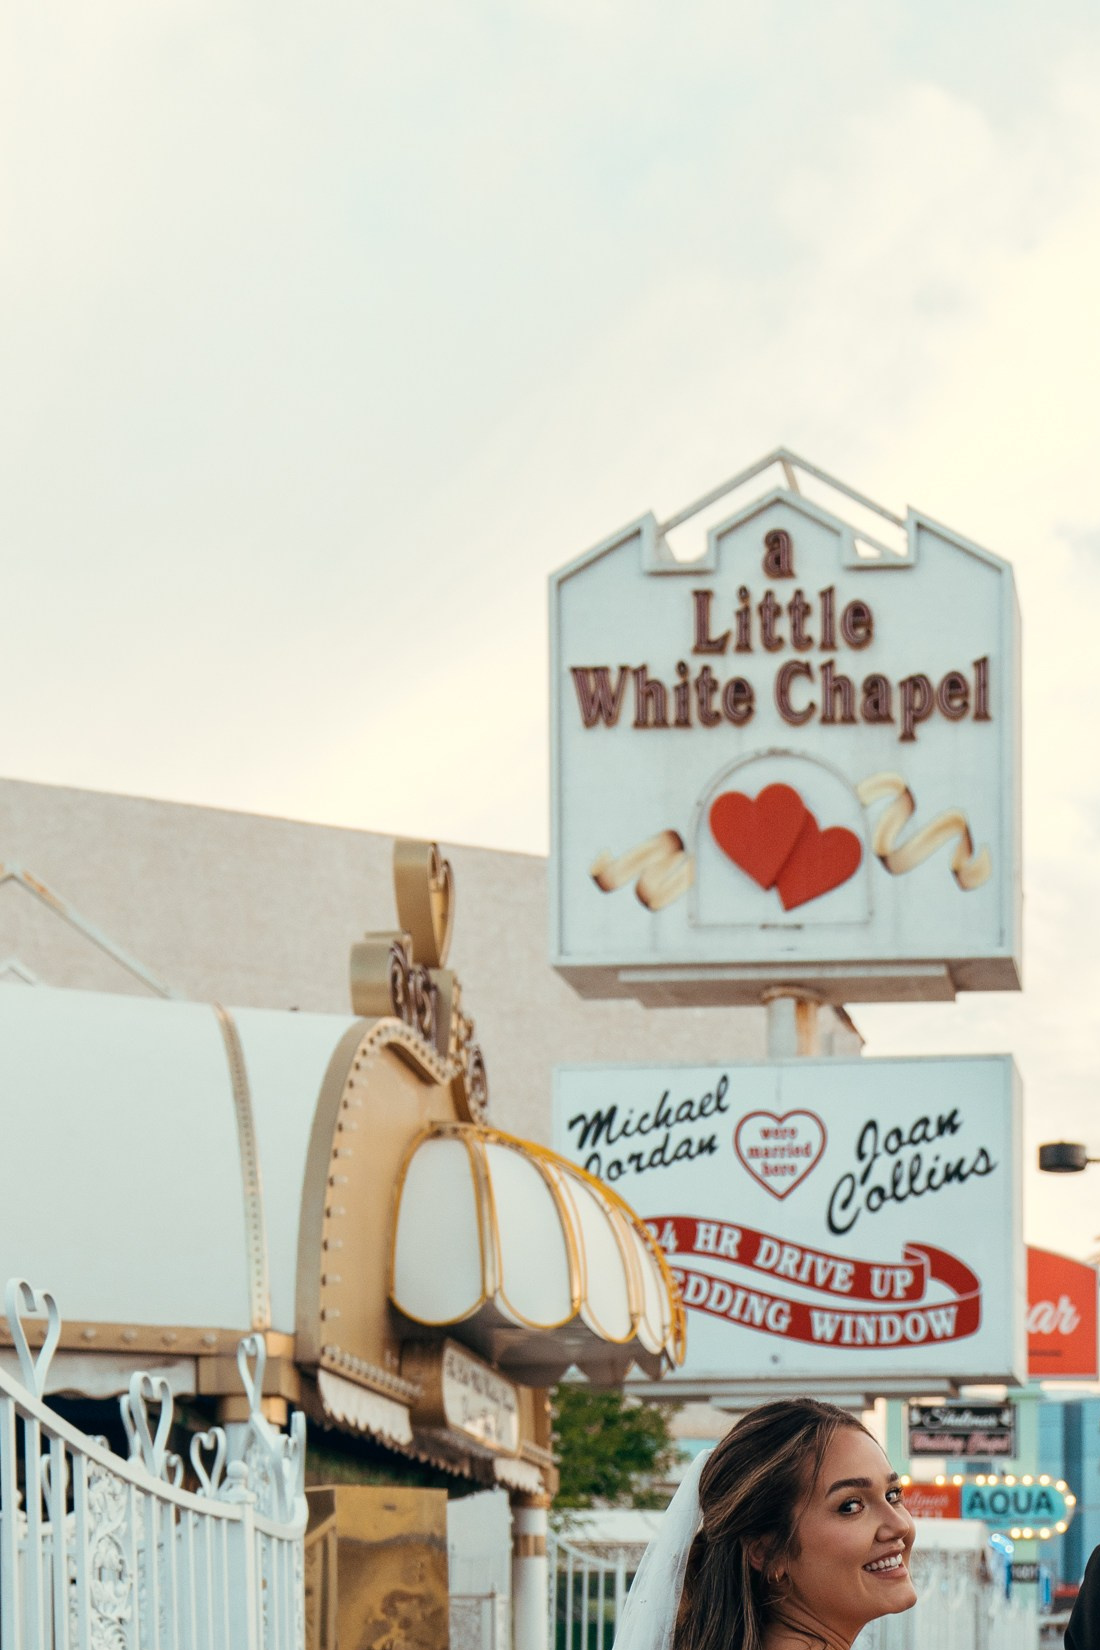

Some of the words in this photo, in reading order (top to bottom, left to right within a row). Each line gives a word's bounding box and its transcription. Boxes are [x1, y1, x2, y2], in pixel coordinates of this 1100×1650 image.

[762, 528, 796, 580] a
[692, 585, 874, 655] Little
[569, 660, 756, 730] White
[774, 655, 993, 743] Chapel
[568, 1073, 730, 1149] Michael
[760, 1126, 798, 1140] were
[856, 1108, 962, 1186] Joan
[747, 1142, 812, 1159] married
[760, 1162, 797, 1177] here
[825, 1147, 998, 1236] Collins
[693, 1222, 743, 1259] HR
[754, 1237, 855, 1293] DRIVE
[869, 1266, 915, 1299] UP
[672, 1270, 792, 1332] DDING
[809, 1305, 959, 1345] WINDOW
[966, 1488, 1056, 1516] AQUA
